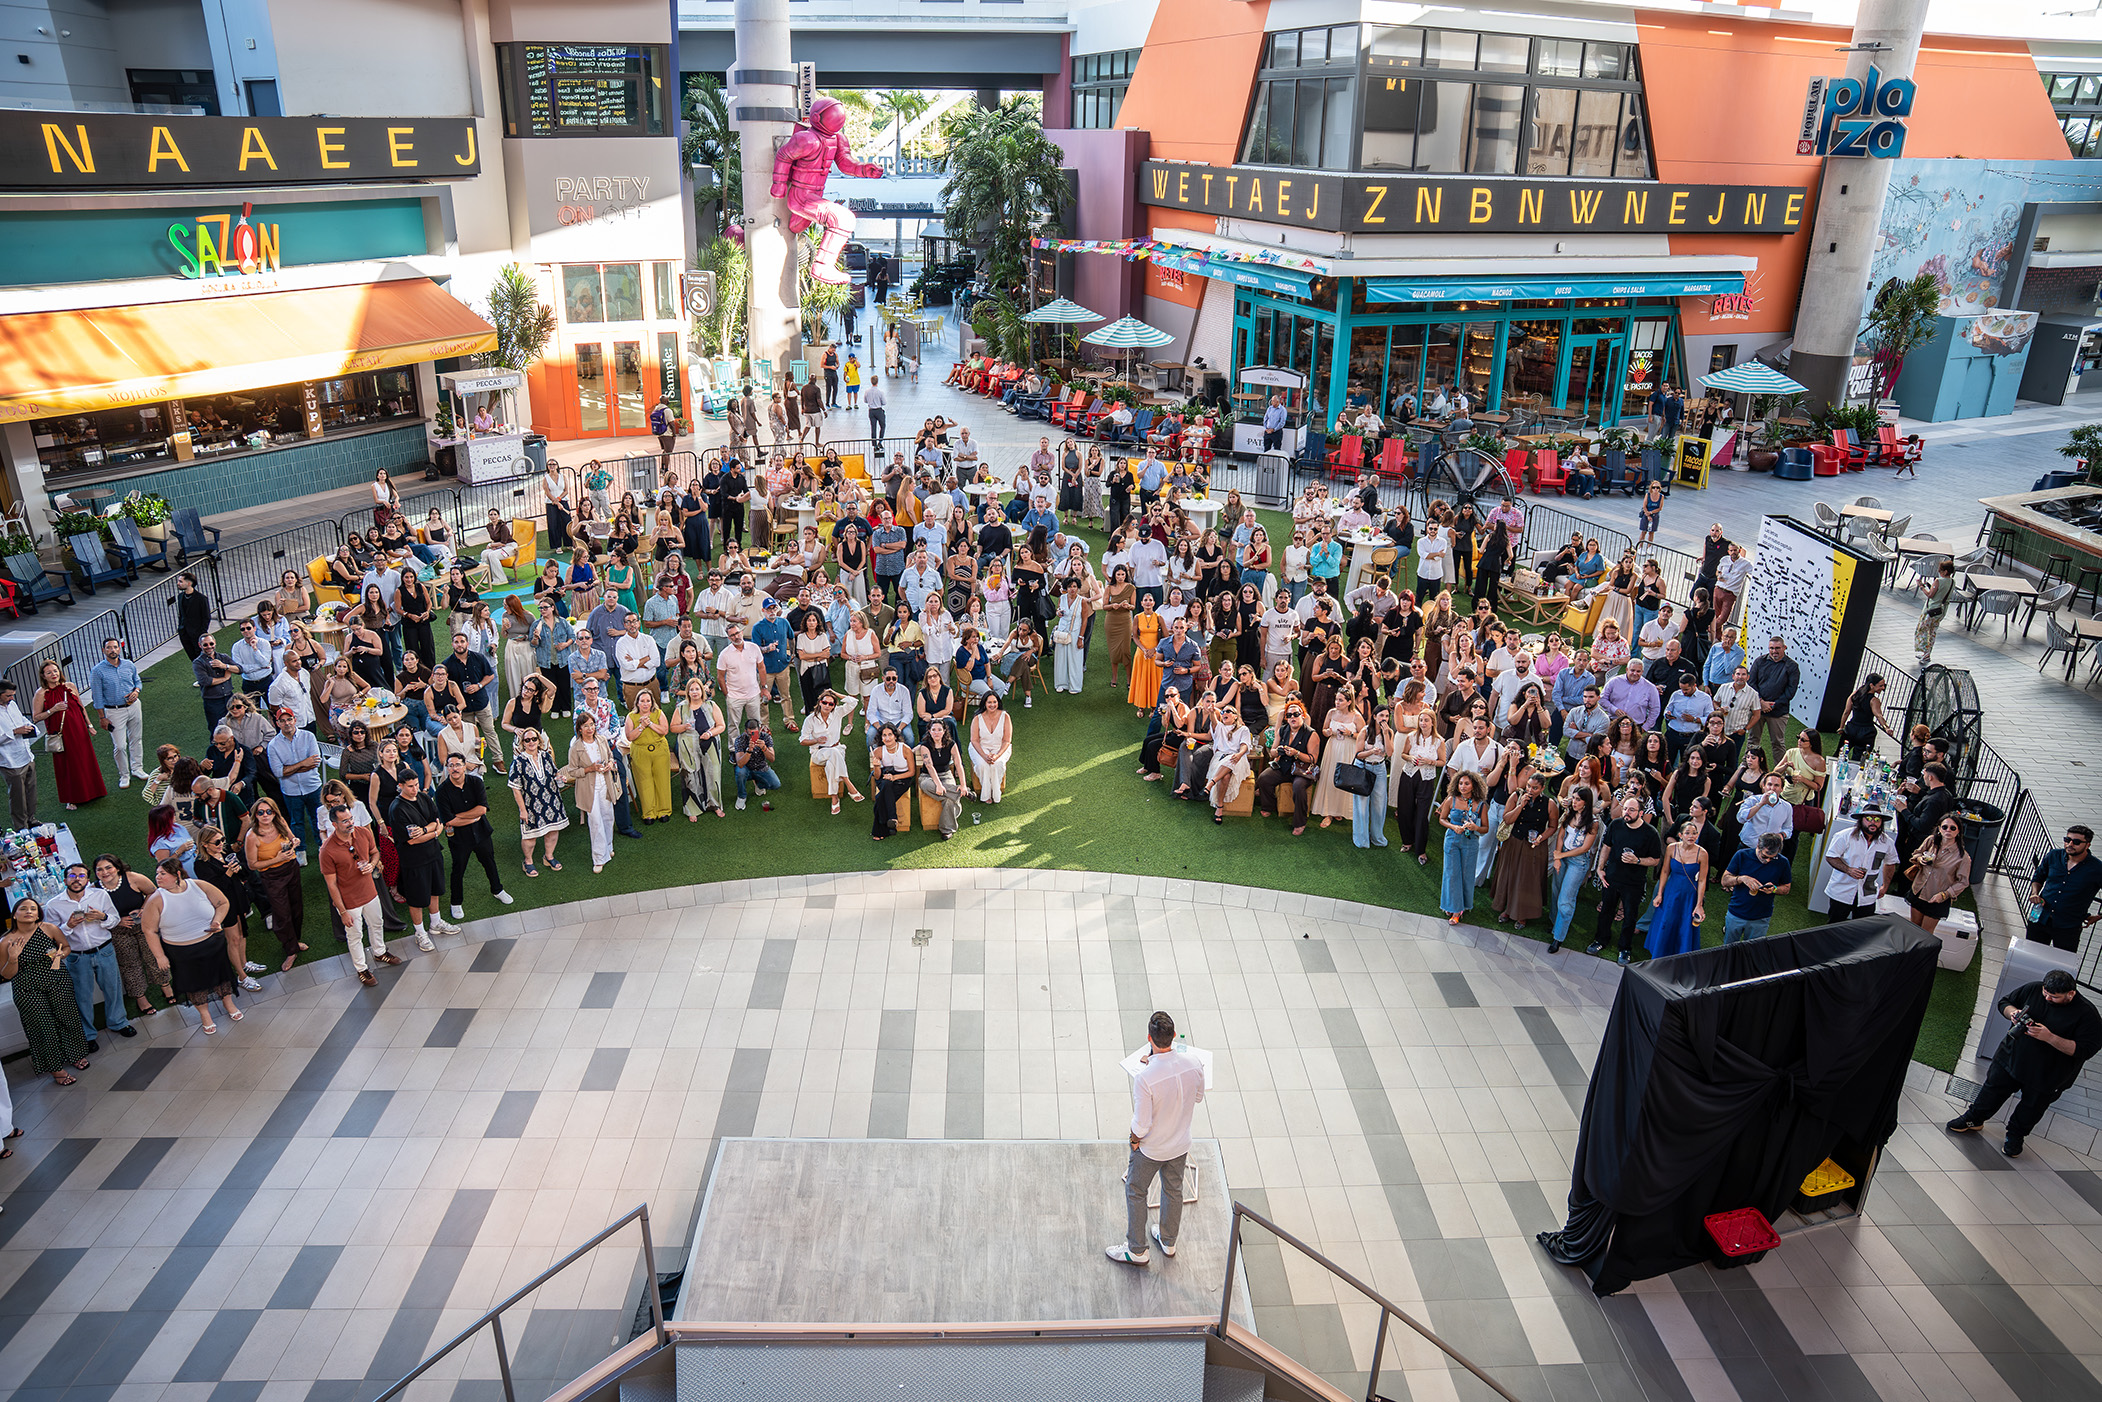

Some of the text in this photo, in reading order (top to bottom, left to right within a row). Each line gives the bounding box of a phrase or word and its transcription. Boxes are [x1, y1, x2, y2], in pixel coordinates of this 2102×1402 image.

[803, 65, 811, 115] POPULAR
[1803, 79, 1822, 139] POPULAR
[555, 176, 650, 202] PARTY
[557, 205, 595, 226] ON
[1160, 266, 1183, 286] REYES
[691, 291, 706, 310] S
[1412, 290, 1446, 299] GUACAMOLE
[1491, 288, 1513, 297] NACHOS
[1554, 286, 1572, 295] QUESO
[1612, 287, 1627, 295] CHIPS
[1630, 286, 1646, 294] SALSA
[1683, 284, 1711, 292] MARGARITAS
[1711, 296, 1754, 316] REYES
[2062, 333, 2079, 341] ATM
[428, 340, 478, 357] MOFONGO
[1634, 350, 1654, 359] TACOS
[664, 347, 677, 398] Sample:
[475, 379, 503, 388] PECCAS
[1630, 382, 1653, 391] PASTOR
[107, 386, 168, 404] MOJITOS
[482, 454, 512, 466] PECCAS
[1684, 454, 1703, 466] TACOS
[176, 801, 192, 821] 3
